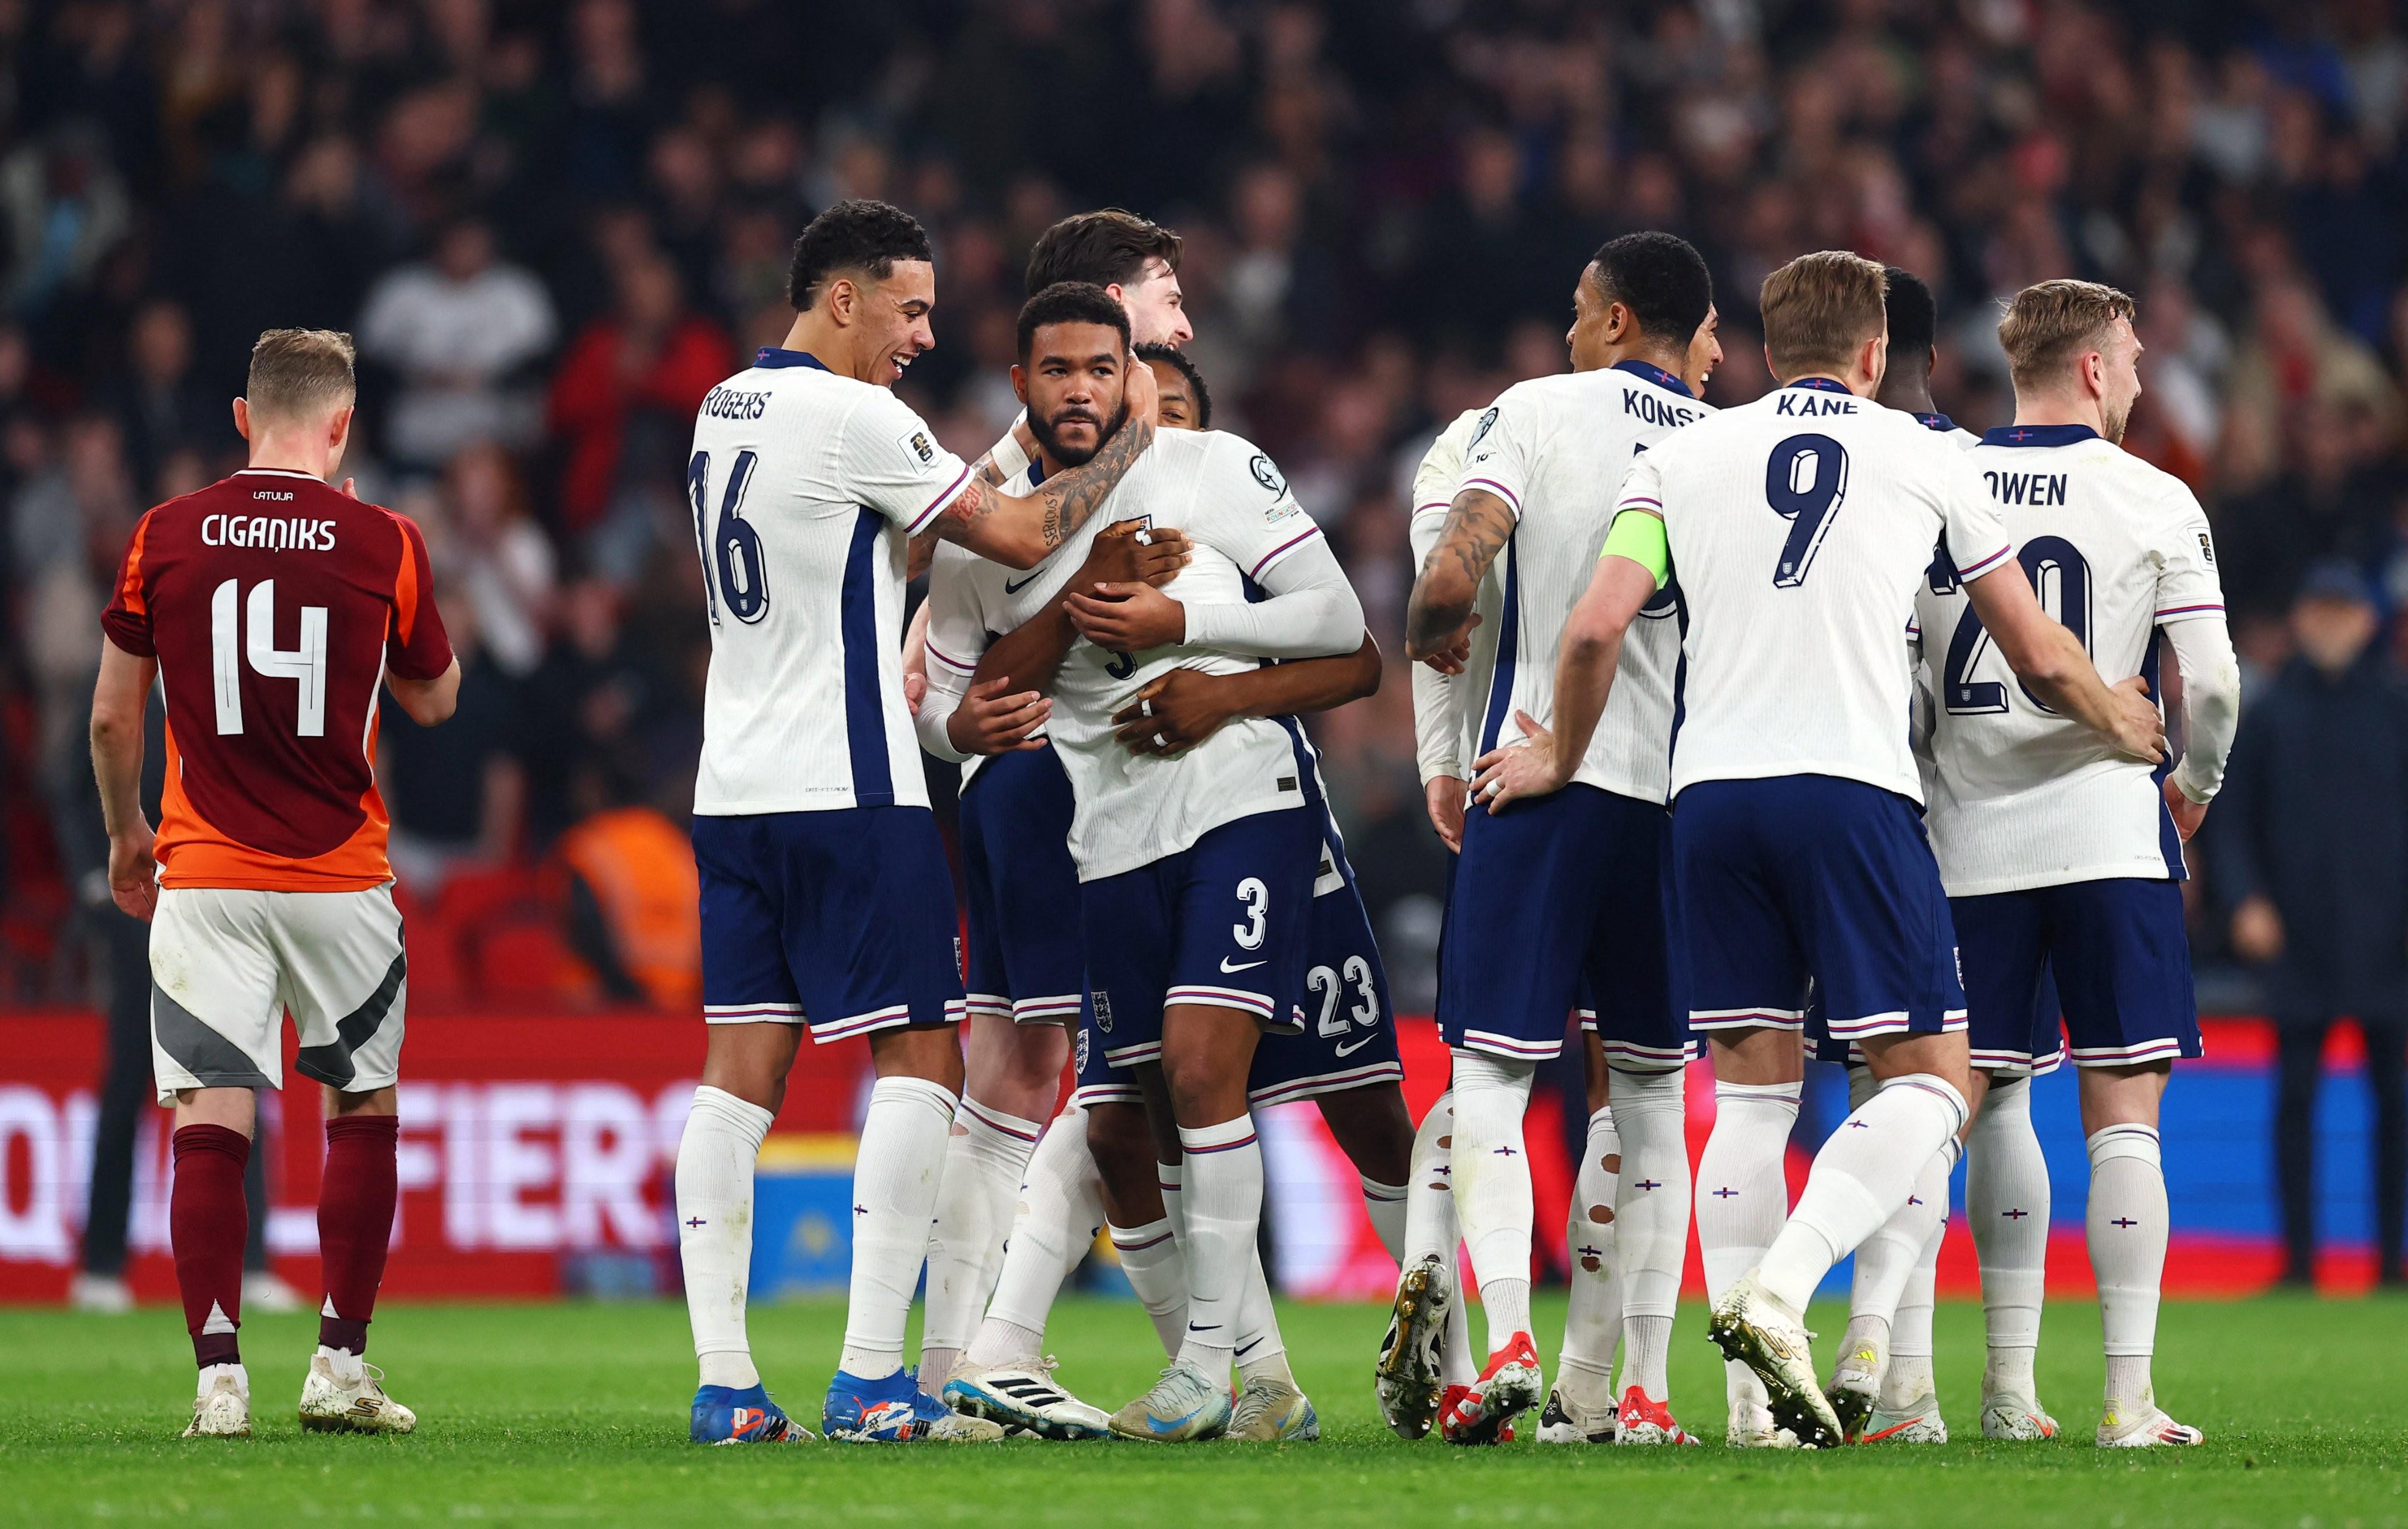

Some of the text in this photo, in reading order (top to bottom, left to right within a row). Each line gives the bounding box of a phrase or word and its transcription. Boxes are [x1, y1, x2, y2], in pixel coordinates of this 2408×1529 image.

[700, 386, 772, 419] ROGERS
[1623, 388, 1706, 428] KONS
[1776, 393, 1858, 416] KANE
[1765, 433, 1849, 589] 9
[1983, 470, 2068, 506] OWEN
[202, 514, 336, 553] CIGAŅIKS
[688, 450, 770, 625] 16
[211, 578, 329, 737] 14
[1943, 535, 2094, 716] 20
[1233, 877, 1269, 950] 3
[1307, 955, 1379, 1039] 23
